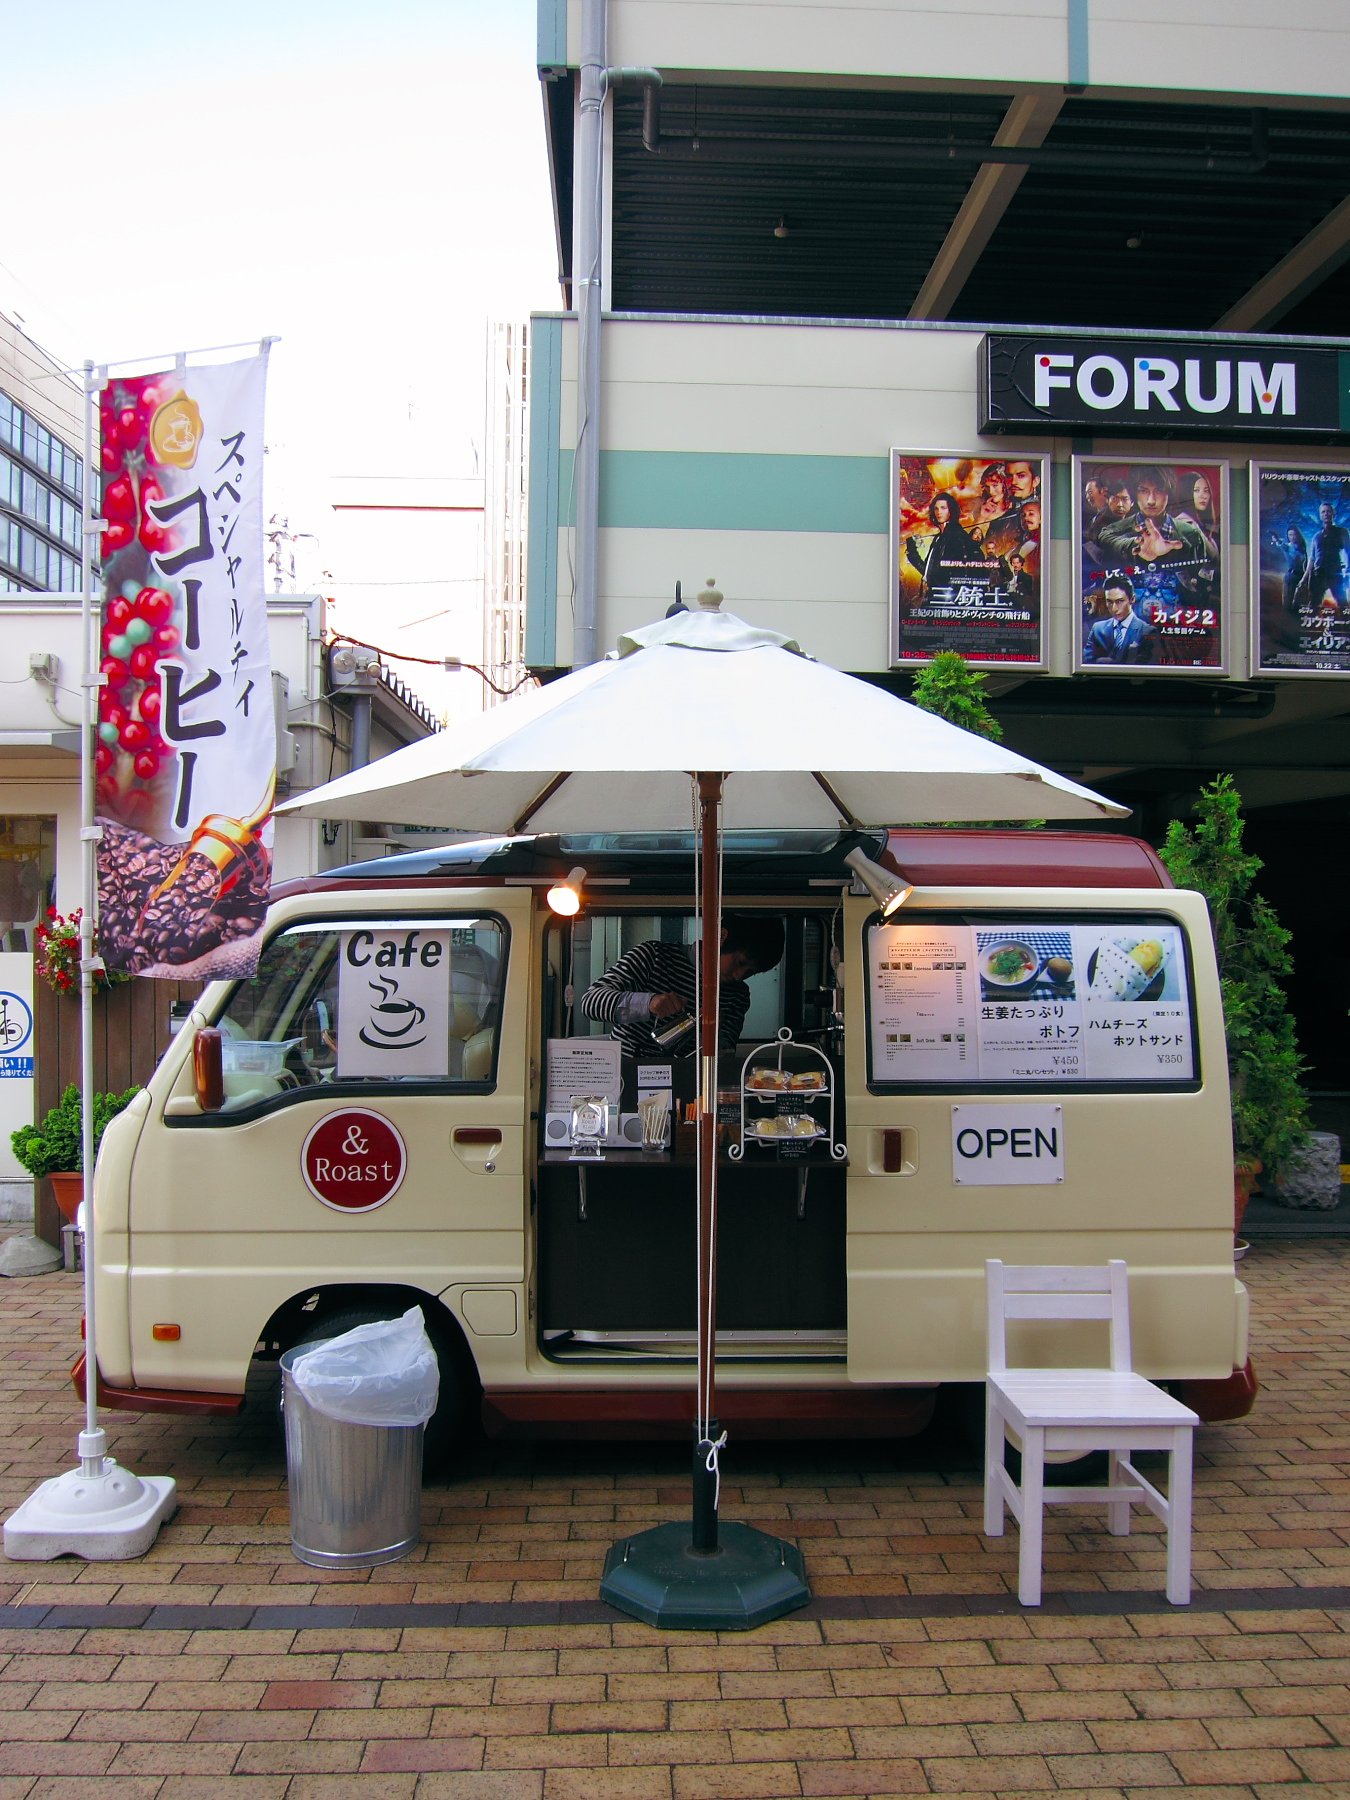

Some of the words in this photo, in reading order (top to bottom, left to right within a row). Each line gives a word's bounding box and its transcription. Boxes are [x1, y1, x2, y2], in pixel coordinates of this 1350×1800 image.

[1034, 354, 1296, 415] FORUM
[213, 431, 254, 717] スペシャルティ
[930, 585, 1010, 607] 三銃士
[1153, 609, 1214, 625] カイジ2
[149, 485, 227, 829] コーヒー
[346, 930, 443, 968] Cafe
[981, 1006, 1064, 1019] 生姜たっぷり
[1040, 1025, 1080, 1038] ポトフ
[1089, 1018, 1148, 1030] ハムチーズ
[1113, 1035, 1184, 1046] ホットサンド
[1052, 1055, 1079, 1065] ¥450
[1157, 1054, 1183, 1063] ¥350
[342, 1126, 369, 1155] &
[956, 1127, 1057, 1159] OPEN
[315, 1158, 394, 1182] Roast
